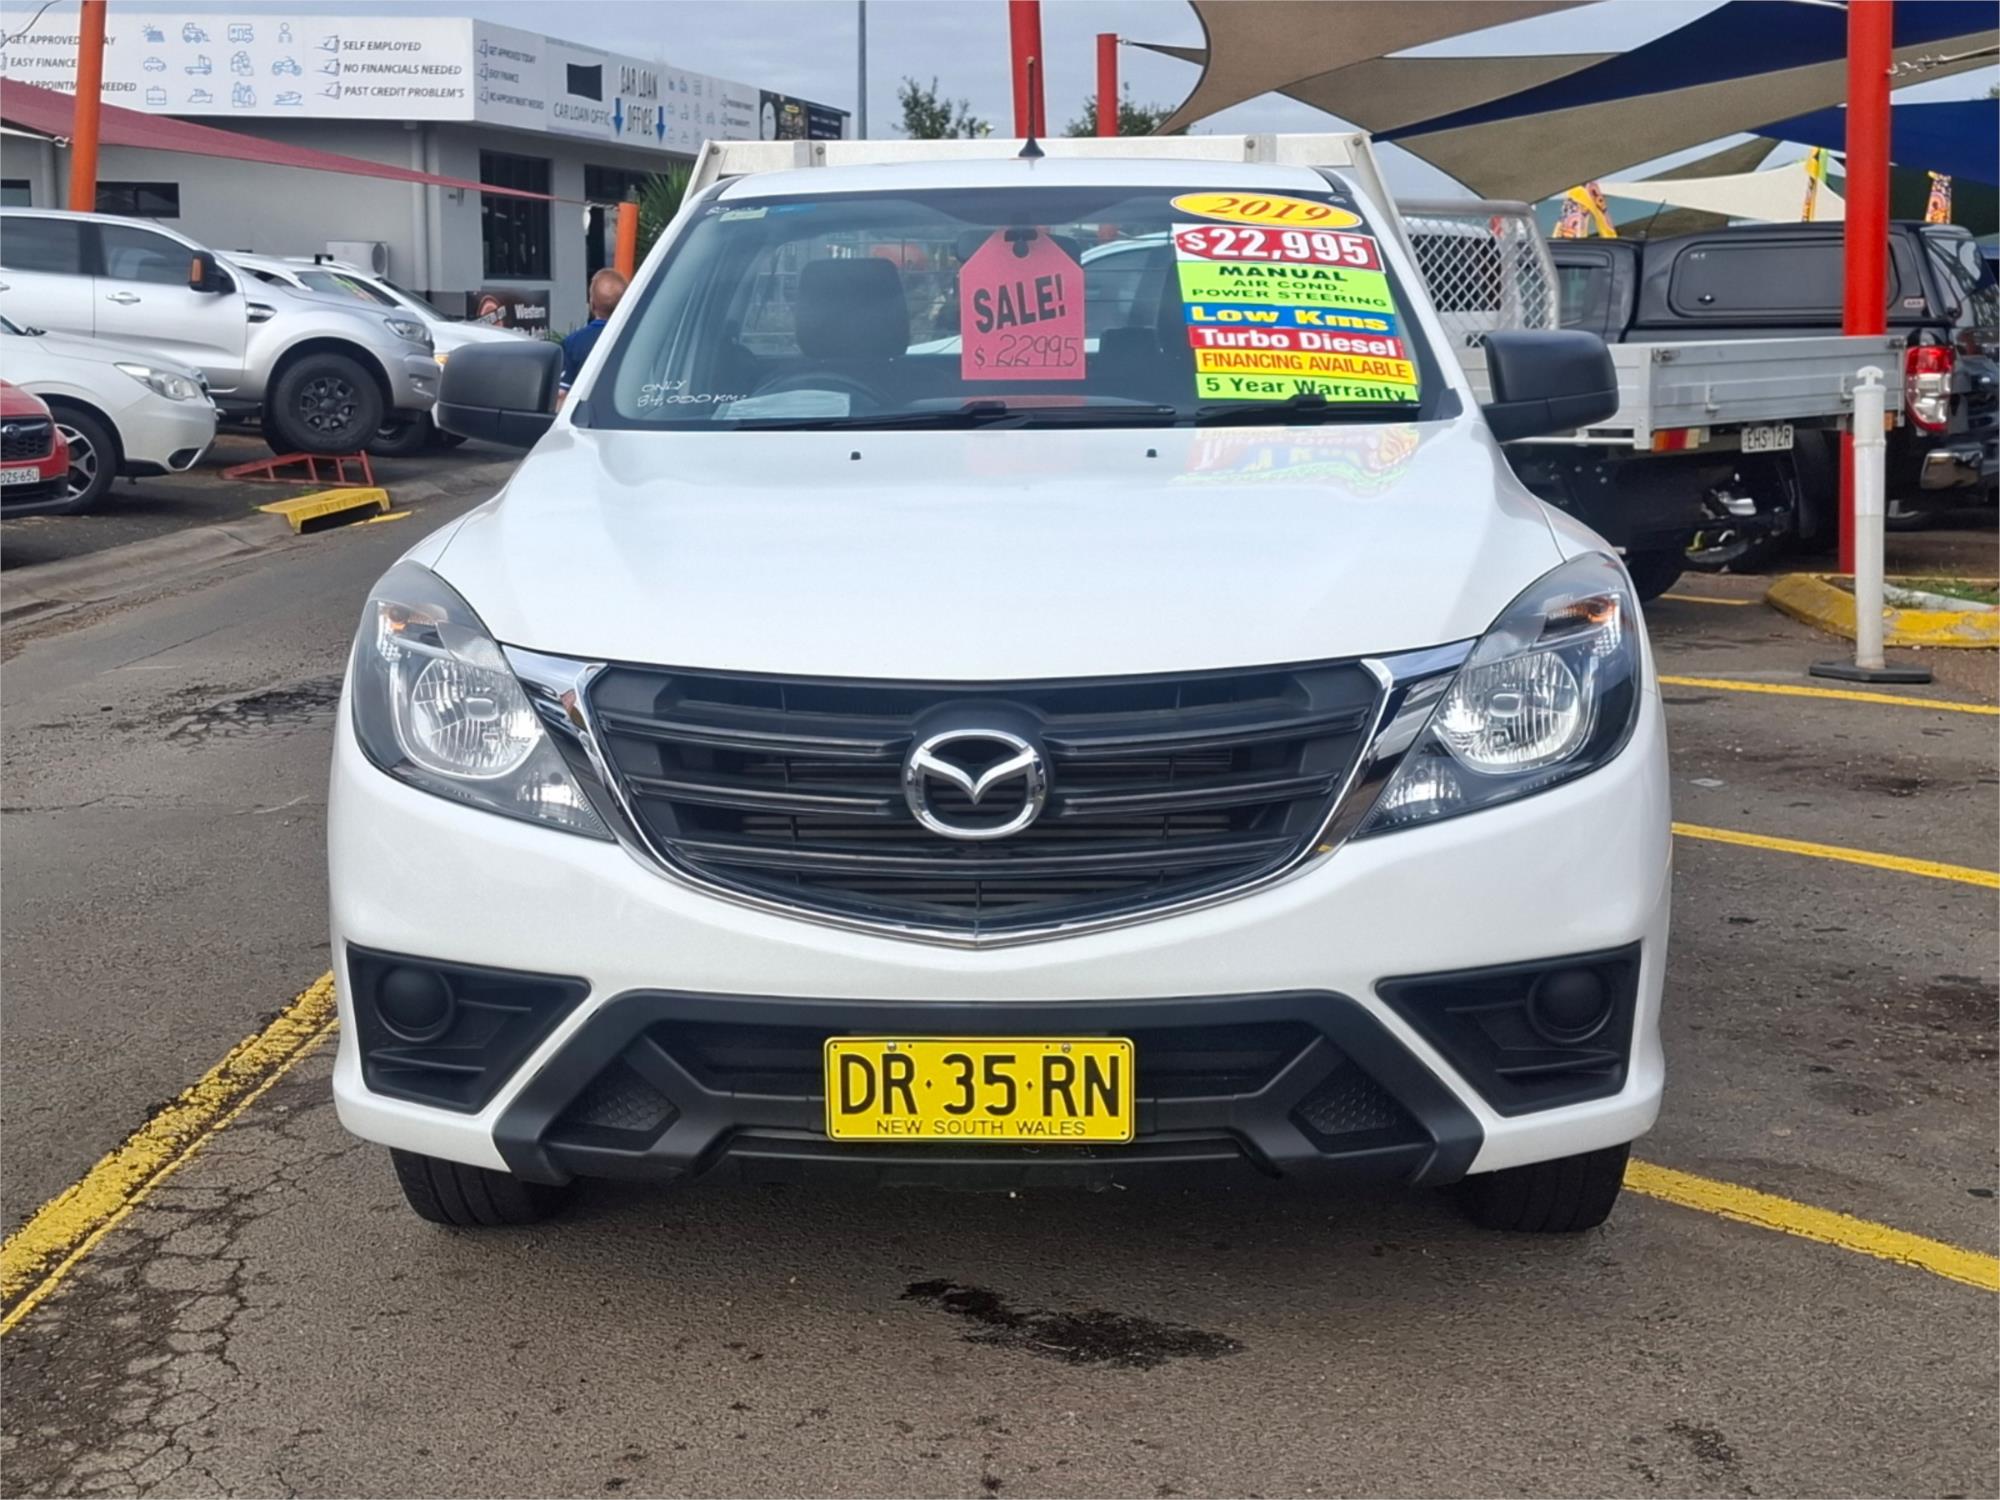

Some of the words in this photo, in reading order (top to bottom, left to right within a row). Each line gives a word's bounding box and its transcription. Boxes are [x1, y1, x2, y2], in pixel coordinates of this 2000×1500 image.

[9, 35, 27, 45] GET
[343, 40, 365, 51] SELF
[367, 41, 421, 52] EMPLOYED
[10, 57, 34, 67] EASY
[36, 57, 77, 68] FINANCE
[344, 64, 359, 74] NO
[361, 65, 419, 75] FINANCIALS
[421, 65, 462, 76] NEEDED
[344, 86, 369, 97] PAST
[370, 87, 407, 97] CREDIT
[408, 88, 465, 99] PROBLEM'S
[553, 102, 569, 119] CAR
[570, 105, 589, 122] LOAN
[1205, 197, 1334, 221] 2019
[1183, 228, 1370, 265] $22,995
[1218, 265, 1349, 283] MANUAL
[1232, 279, 1269, 288] AIR
[1277, 281, 1345, 292] COND.
[973, 273, 1067, 334] SALE!
[1192, 288, 1270, 299] POWER
[1278, 291, 1388, 308] STEERING
[1190, 306, 1281, 323] Low
[1294, 309, 1390, 331] Kms
[997, 334, 1079, 368] 22995
[1197, 328, 1290, 349] Turbo
[1299, 332, 1398, 357] Diesel
[1202, 352, 1304, 371] FINANCING
[1308, 355, 1409, 379] AVAILABLE
[641, 380, 688, 393] ONLY
[1206, 377, 1221, 392] 5
[1229, 377, 1285, 393] Year
[1293, 379, 1407, 400] Warranty
[839, 1052, 919, 1116] DR
[942, 1053, 1017, 1117] 35
[1041, 1054, 1121, 1118] RN
[876, 1119, 924, 1135] NEW
[934, 1120, 1004, 1136] SOUTH
[1015, 1120, 1087, 1136] WALES
